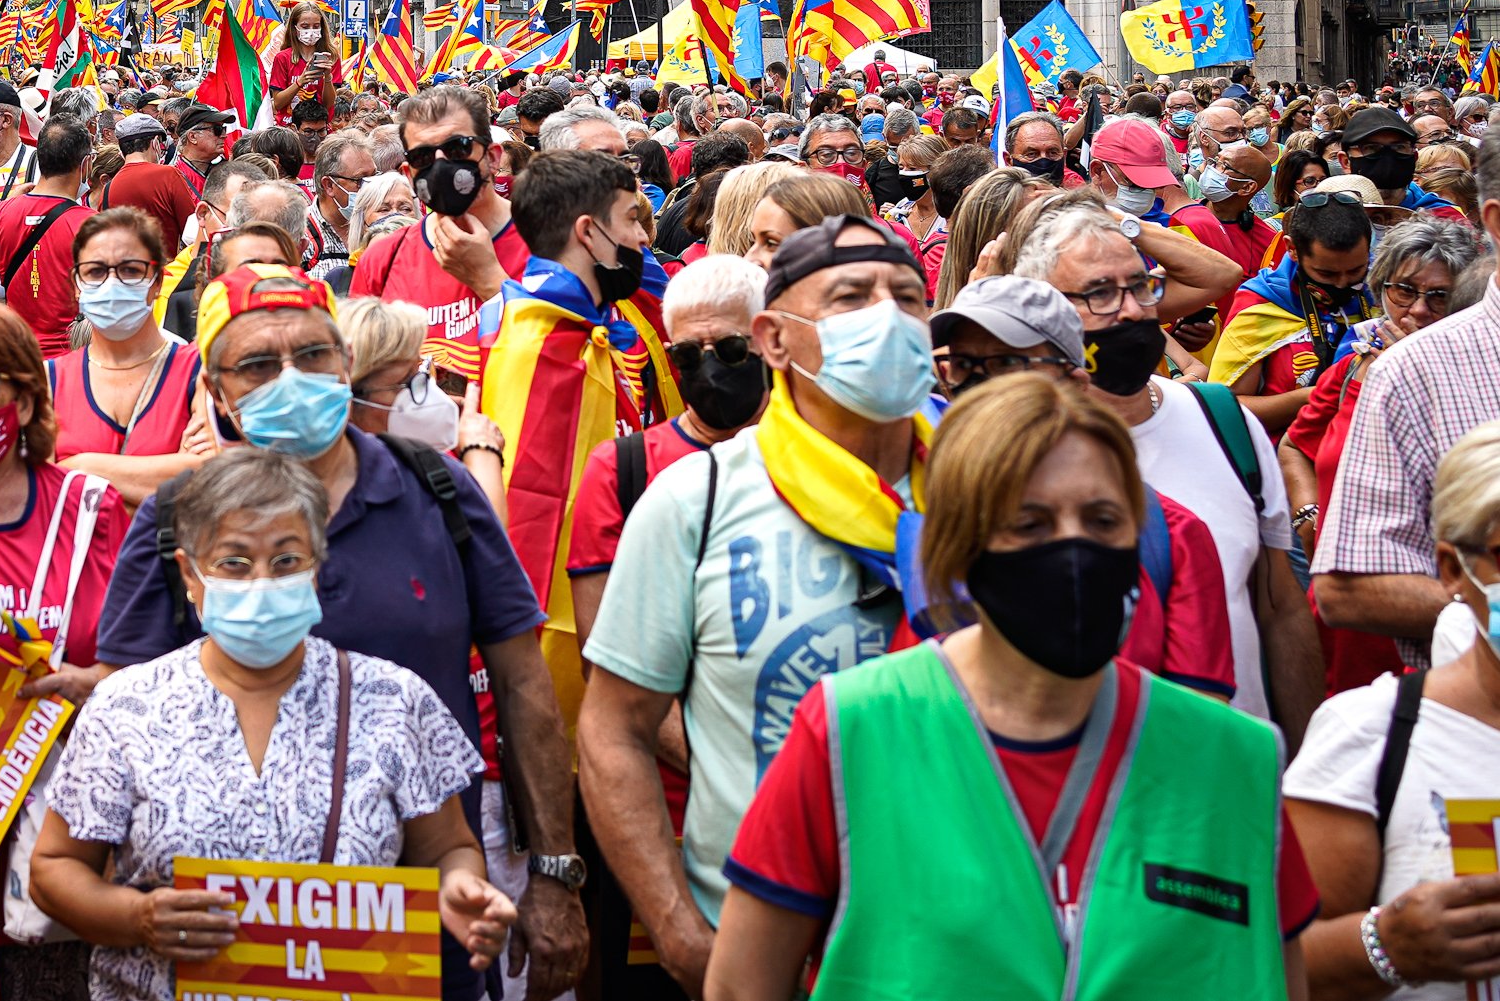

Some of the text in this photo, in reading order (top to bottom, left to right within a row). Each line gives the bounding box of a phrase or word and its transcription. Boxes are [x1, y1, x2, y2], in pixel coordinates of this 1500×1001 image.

[728, 530, 843, 660] BIG
[204, 873, 406, 934] EXIGIM
[1155, 875, 1242, 912] assemblea
[284, 939, 326, 981] LA
